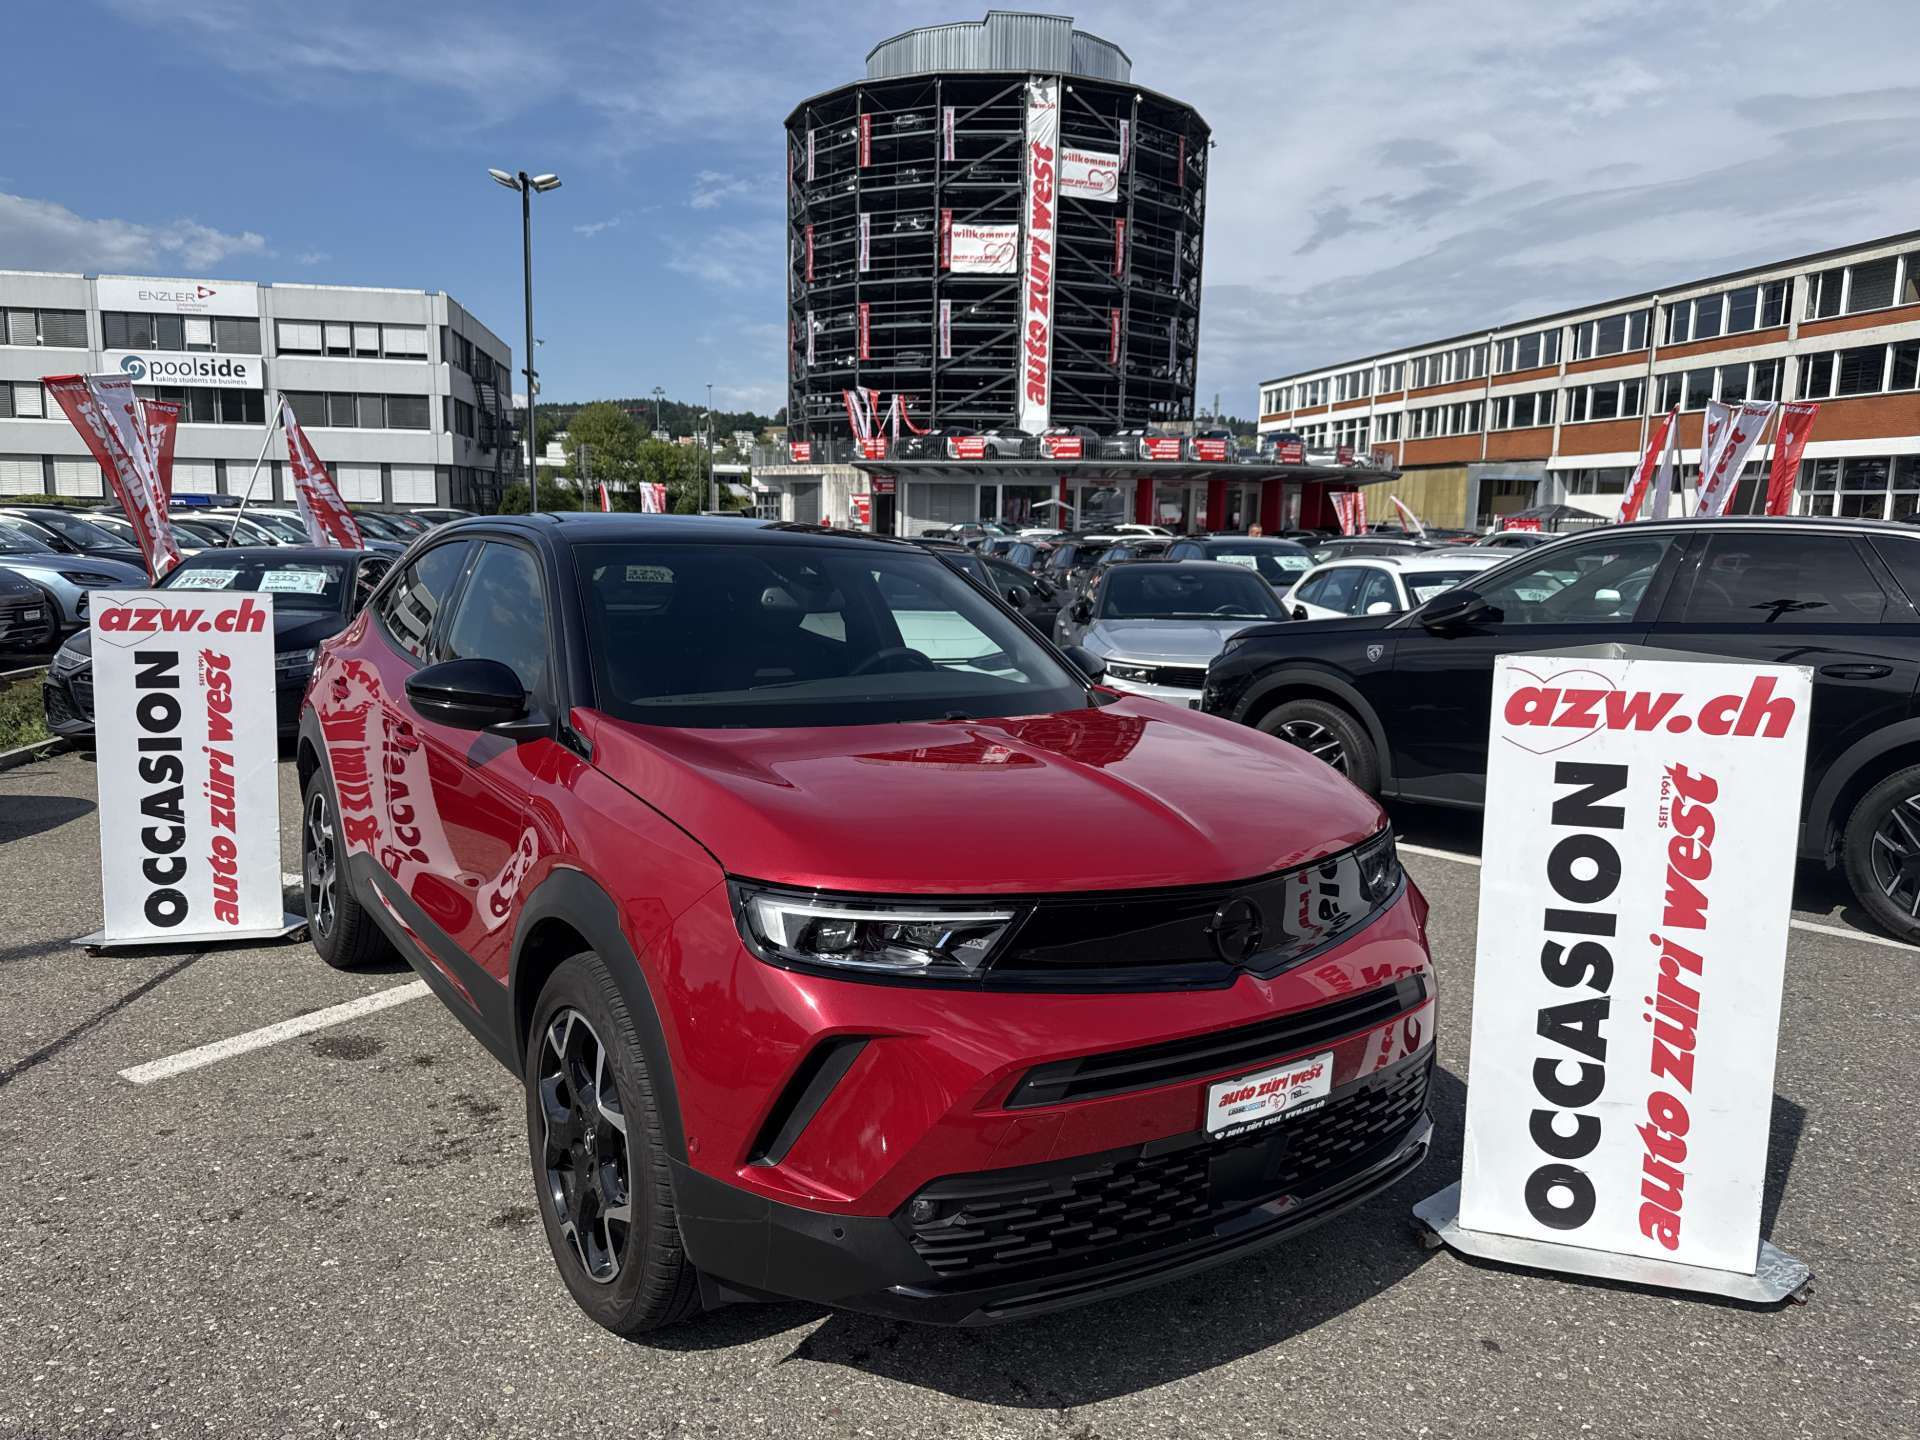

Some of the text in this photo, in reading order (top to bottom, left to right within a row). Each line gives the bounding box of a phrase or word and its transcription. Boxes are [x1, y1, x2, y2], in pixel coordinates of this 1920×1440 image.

[1061, 153, 1118, 168] willkommen
[953, 228, 1016, 239] willkommen
[138, 290, 196, 302] ENZLER
[1025, 140, 1054, 406] auto züri west
[150, 357, 246, 381] poolside
[99, 598, 267, 633] azw.ch
[1503, 676, 1797, 739] azw.ch
[134, 650, 190, 928] OCCASION
[199, 648, 240, 926] auto züri west
[1658, 775, 1672, 829] SEIT 1991
[1524, 761, 1630, 1231] OCCASION
[1635, 762, 1719, 1252] auto züri west
[1218, 1064, 1324, 1108] auto züri west
[1226, 1126, 1245, 1138] auto
[1246, 1119, 1265, 1132] züri
[1264, 1114, 1283, 1126] west
